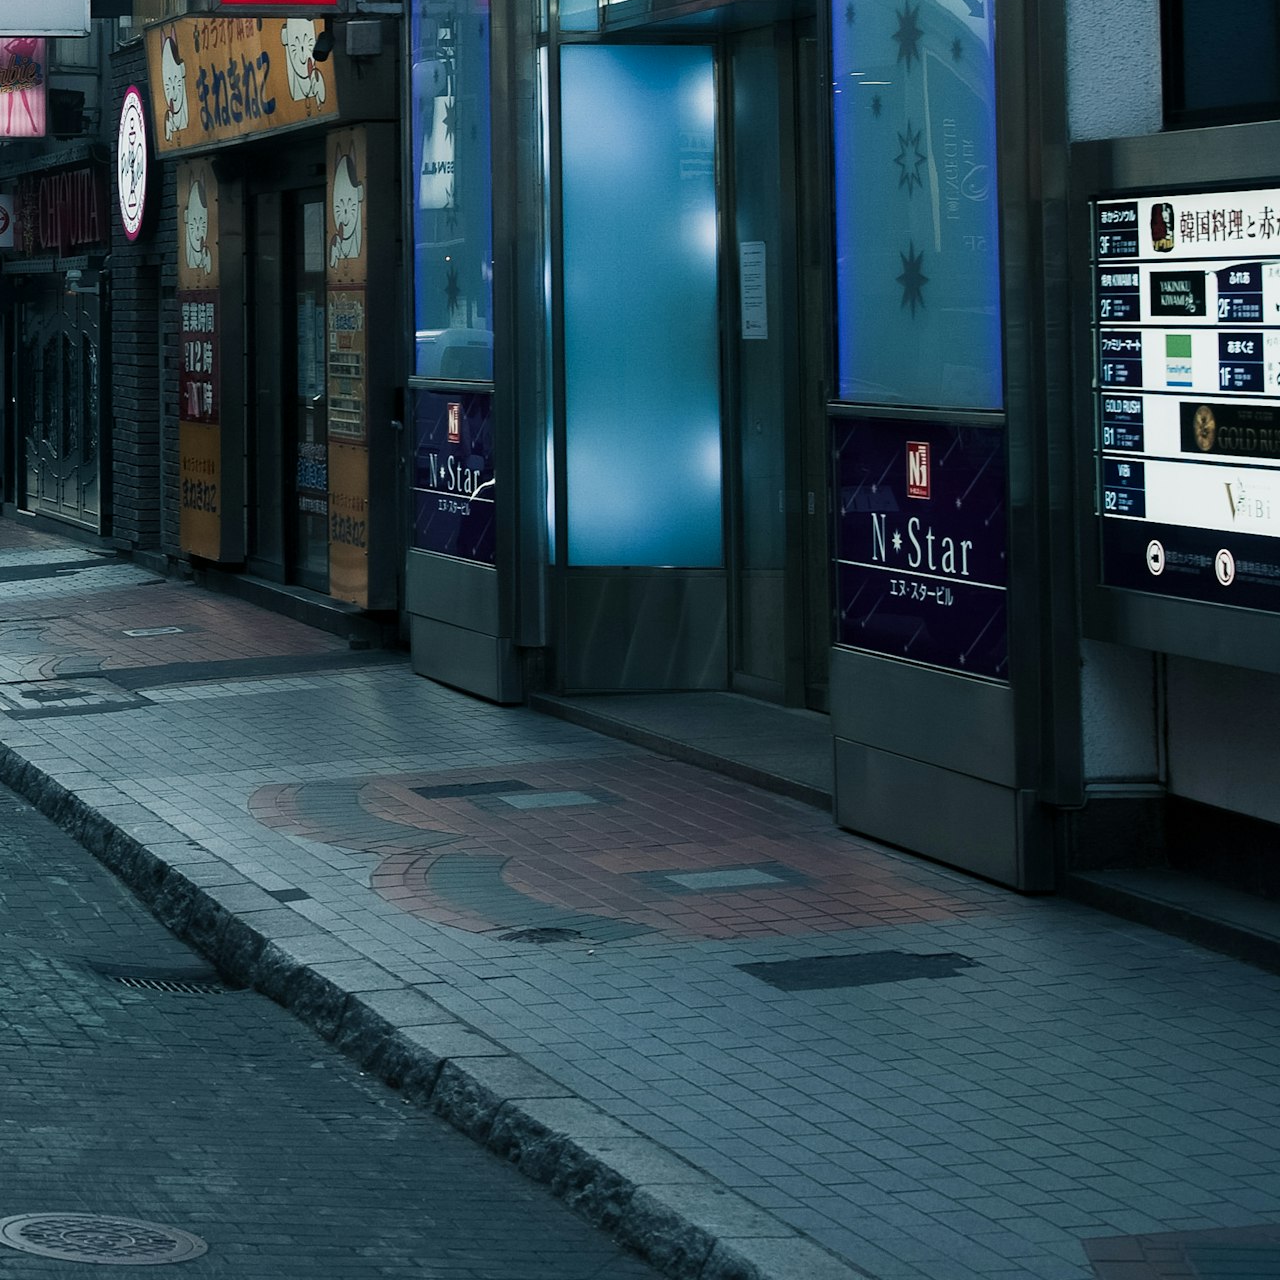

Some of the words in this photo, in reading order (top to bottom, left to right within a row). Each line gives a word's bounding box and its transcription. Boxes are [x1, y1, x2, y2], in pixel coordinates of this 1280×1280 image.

[196, 50, 277, 131] まねきねこ
[1179, 205, 1280, 244] 韓国料理と赤
[1099, 235, 1111, 255] 3F
[1159, 280, 1191, 293] YAKINIKU
[181, 302, 215, 333] 営業時間
[1100, 298, 1112, 318] 2F
[1218, 297, 1231, 319] 2F
[1101, 337, 1142, 352] ファミリーマート
[1227, 340, 1255, 355] あまくさ
[1103, 363, 1114, 382] 1F
[1219, 367, 1231, 387] 1F
[1105, 399, 1123, 414] GOLD
[1123, 399, 1141, 415] RUSH
[1103, 426, 1115, 446] B1
[1218, 425, 1258, 451] GOLD
[428, 452, 439, 488] N
[446, 454, 481, 495] Star
[182, 477, 218, 514] まねきねこ
[1104, 490, 1118, 511] B2
[870, 512, 887, 563] N
[907, 516, 973, 576] Star
[889, 579, 955, 607] エヌ・スタービル
